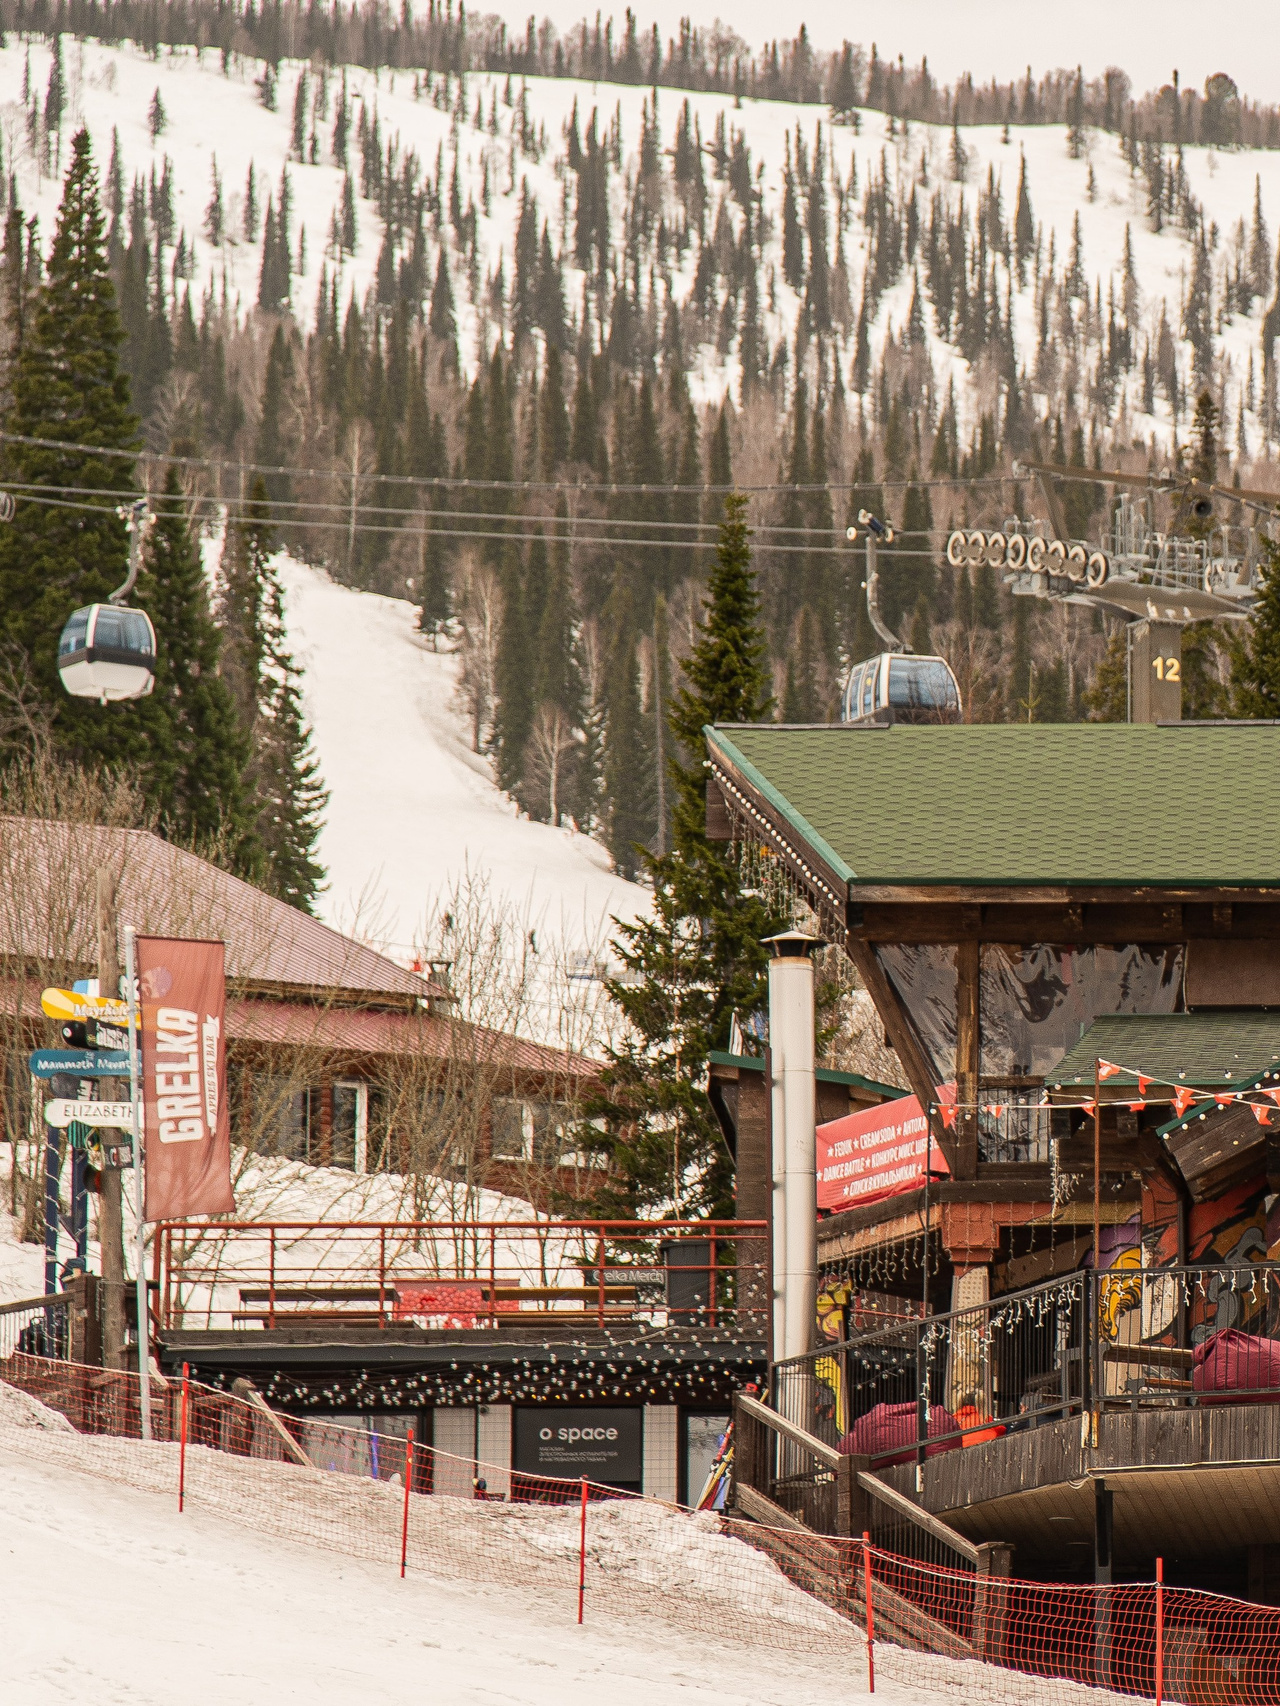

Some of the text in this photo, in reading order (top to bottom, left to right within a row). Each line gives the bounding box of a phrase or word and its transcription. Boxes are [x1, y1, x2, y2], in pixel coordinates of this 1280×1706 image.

[1152, 656, 1181, 682] 12
[205, 1035, 214, 1056] BAR
[37, 1058, 142, 1071] Mammoth Mountn
[157, 1007, 203, 1143] GRELKA
[628, 1269, 664, 1283] Merch
[558, 1427, 618, 1444] space
